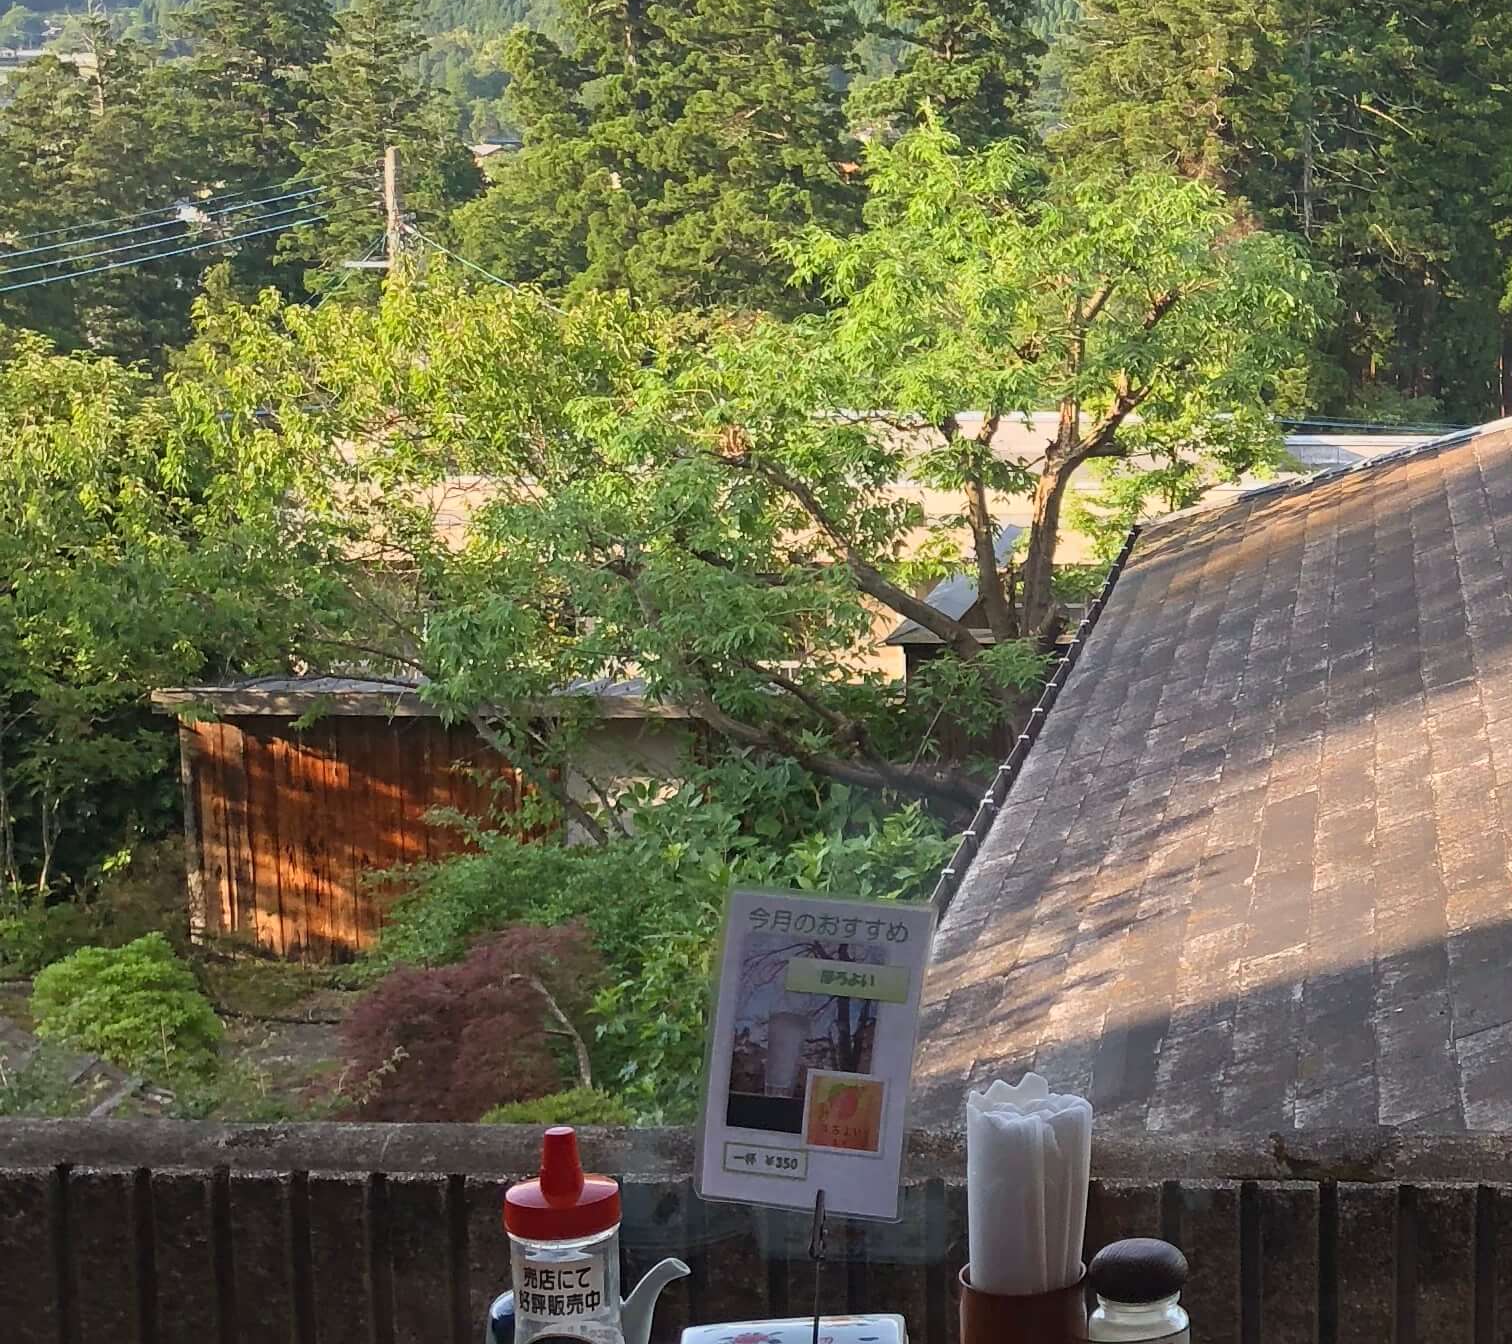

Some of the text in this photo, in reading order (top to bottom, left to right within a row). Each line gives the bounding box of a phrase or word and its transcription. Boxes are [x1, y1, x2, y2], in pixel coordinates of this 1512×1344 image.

[748, 908, 910, 944] 今月のおすすめ
[523, 1265, 592, 1291] 売店にて
[518, 1289, 601, 1317] 好評販売中
